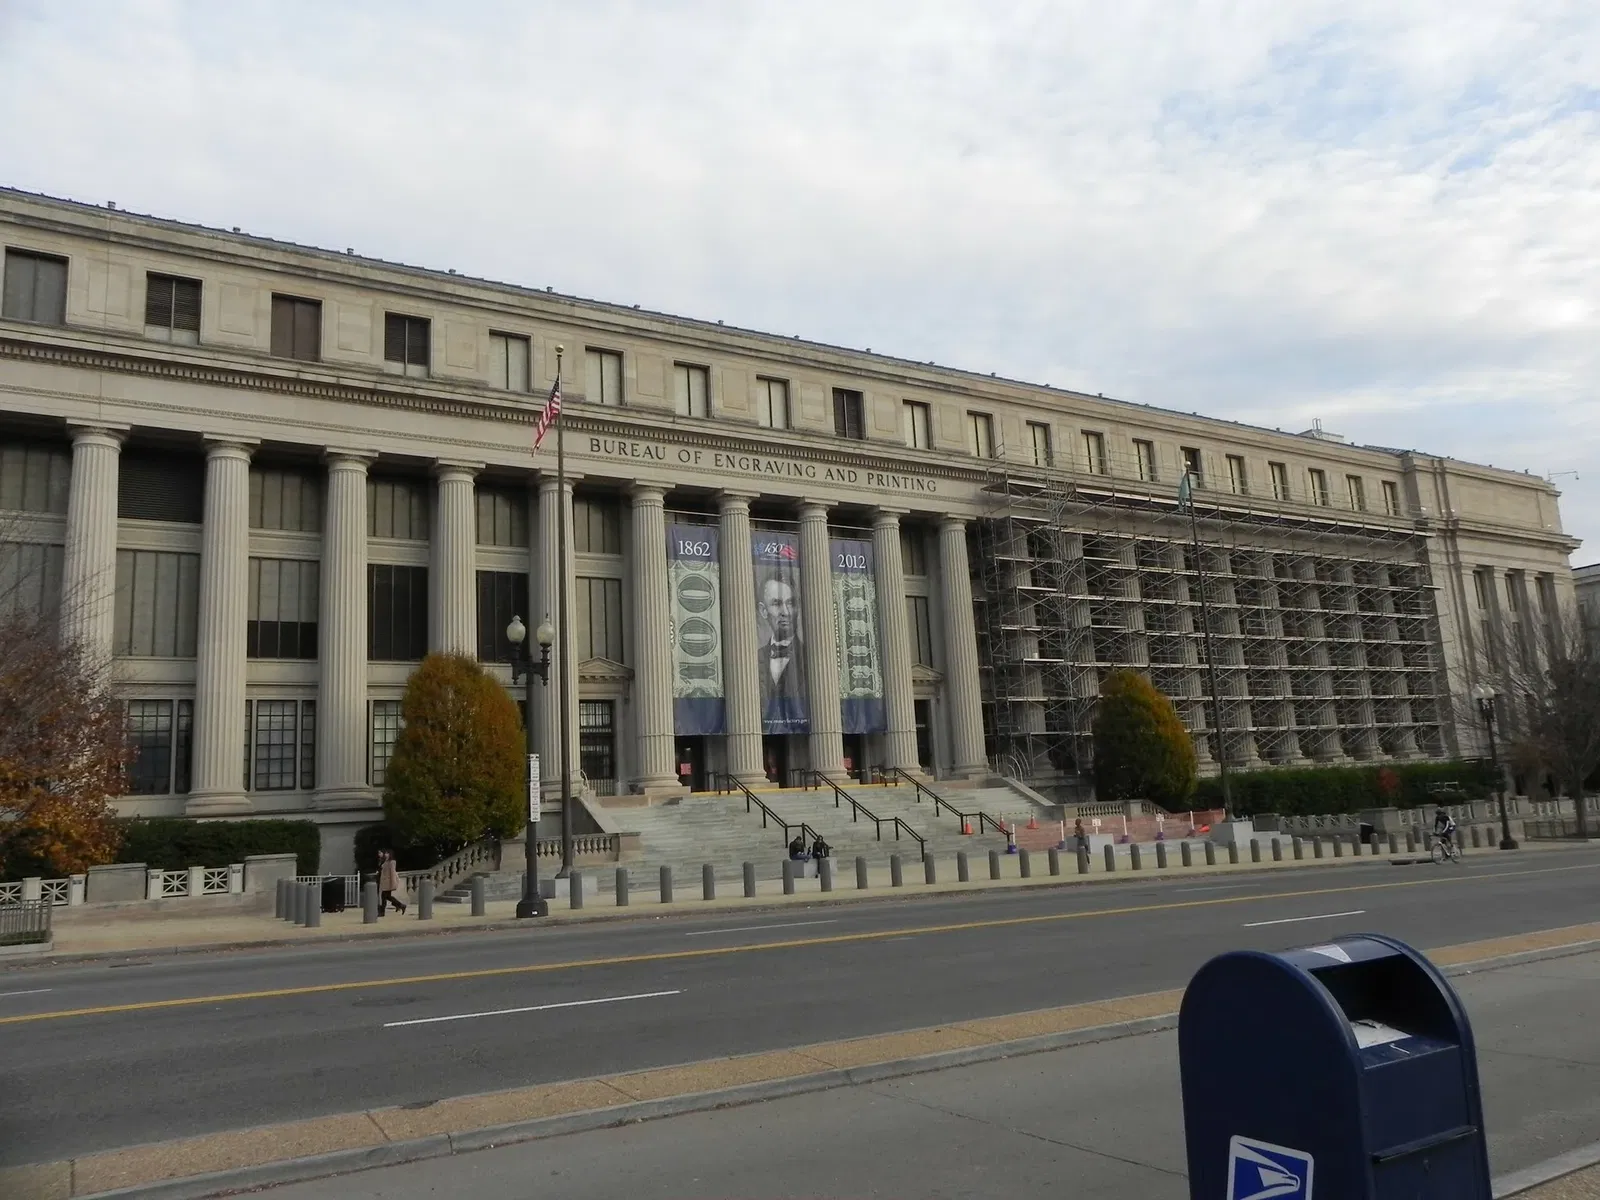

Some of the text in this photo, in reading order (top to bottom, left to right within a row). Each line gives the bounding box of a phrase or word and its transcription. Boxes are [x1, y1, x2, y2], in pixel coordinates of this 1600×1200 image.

[589, 437, 937, 493] BUREAU OF ENGRAVING AND PRINTING
[678, 540, 711, 557] 1862
[838, 554, 867, 569] 2012
